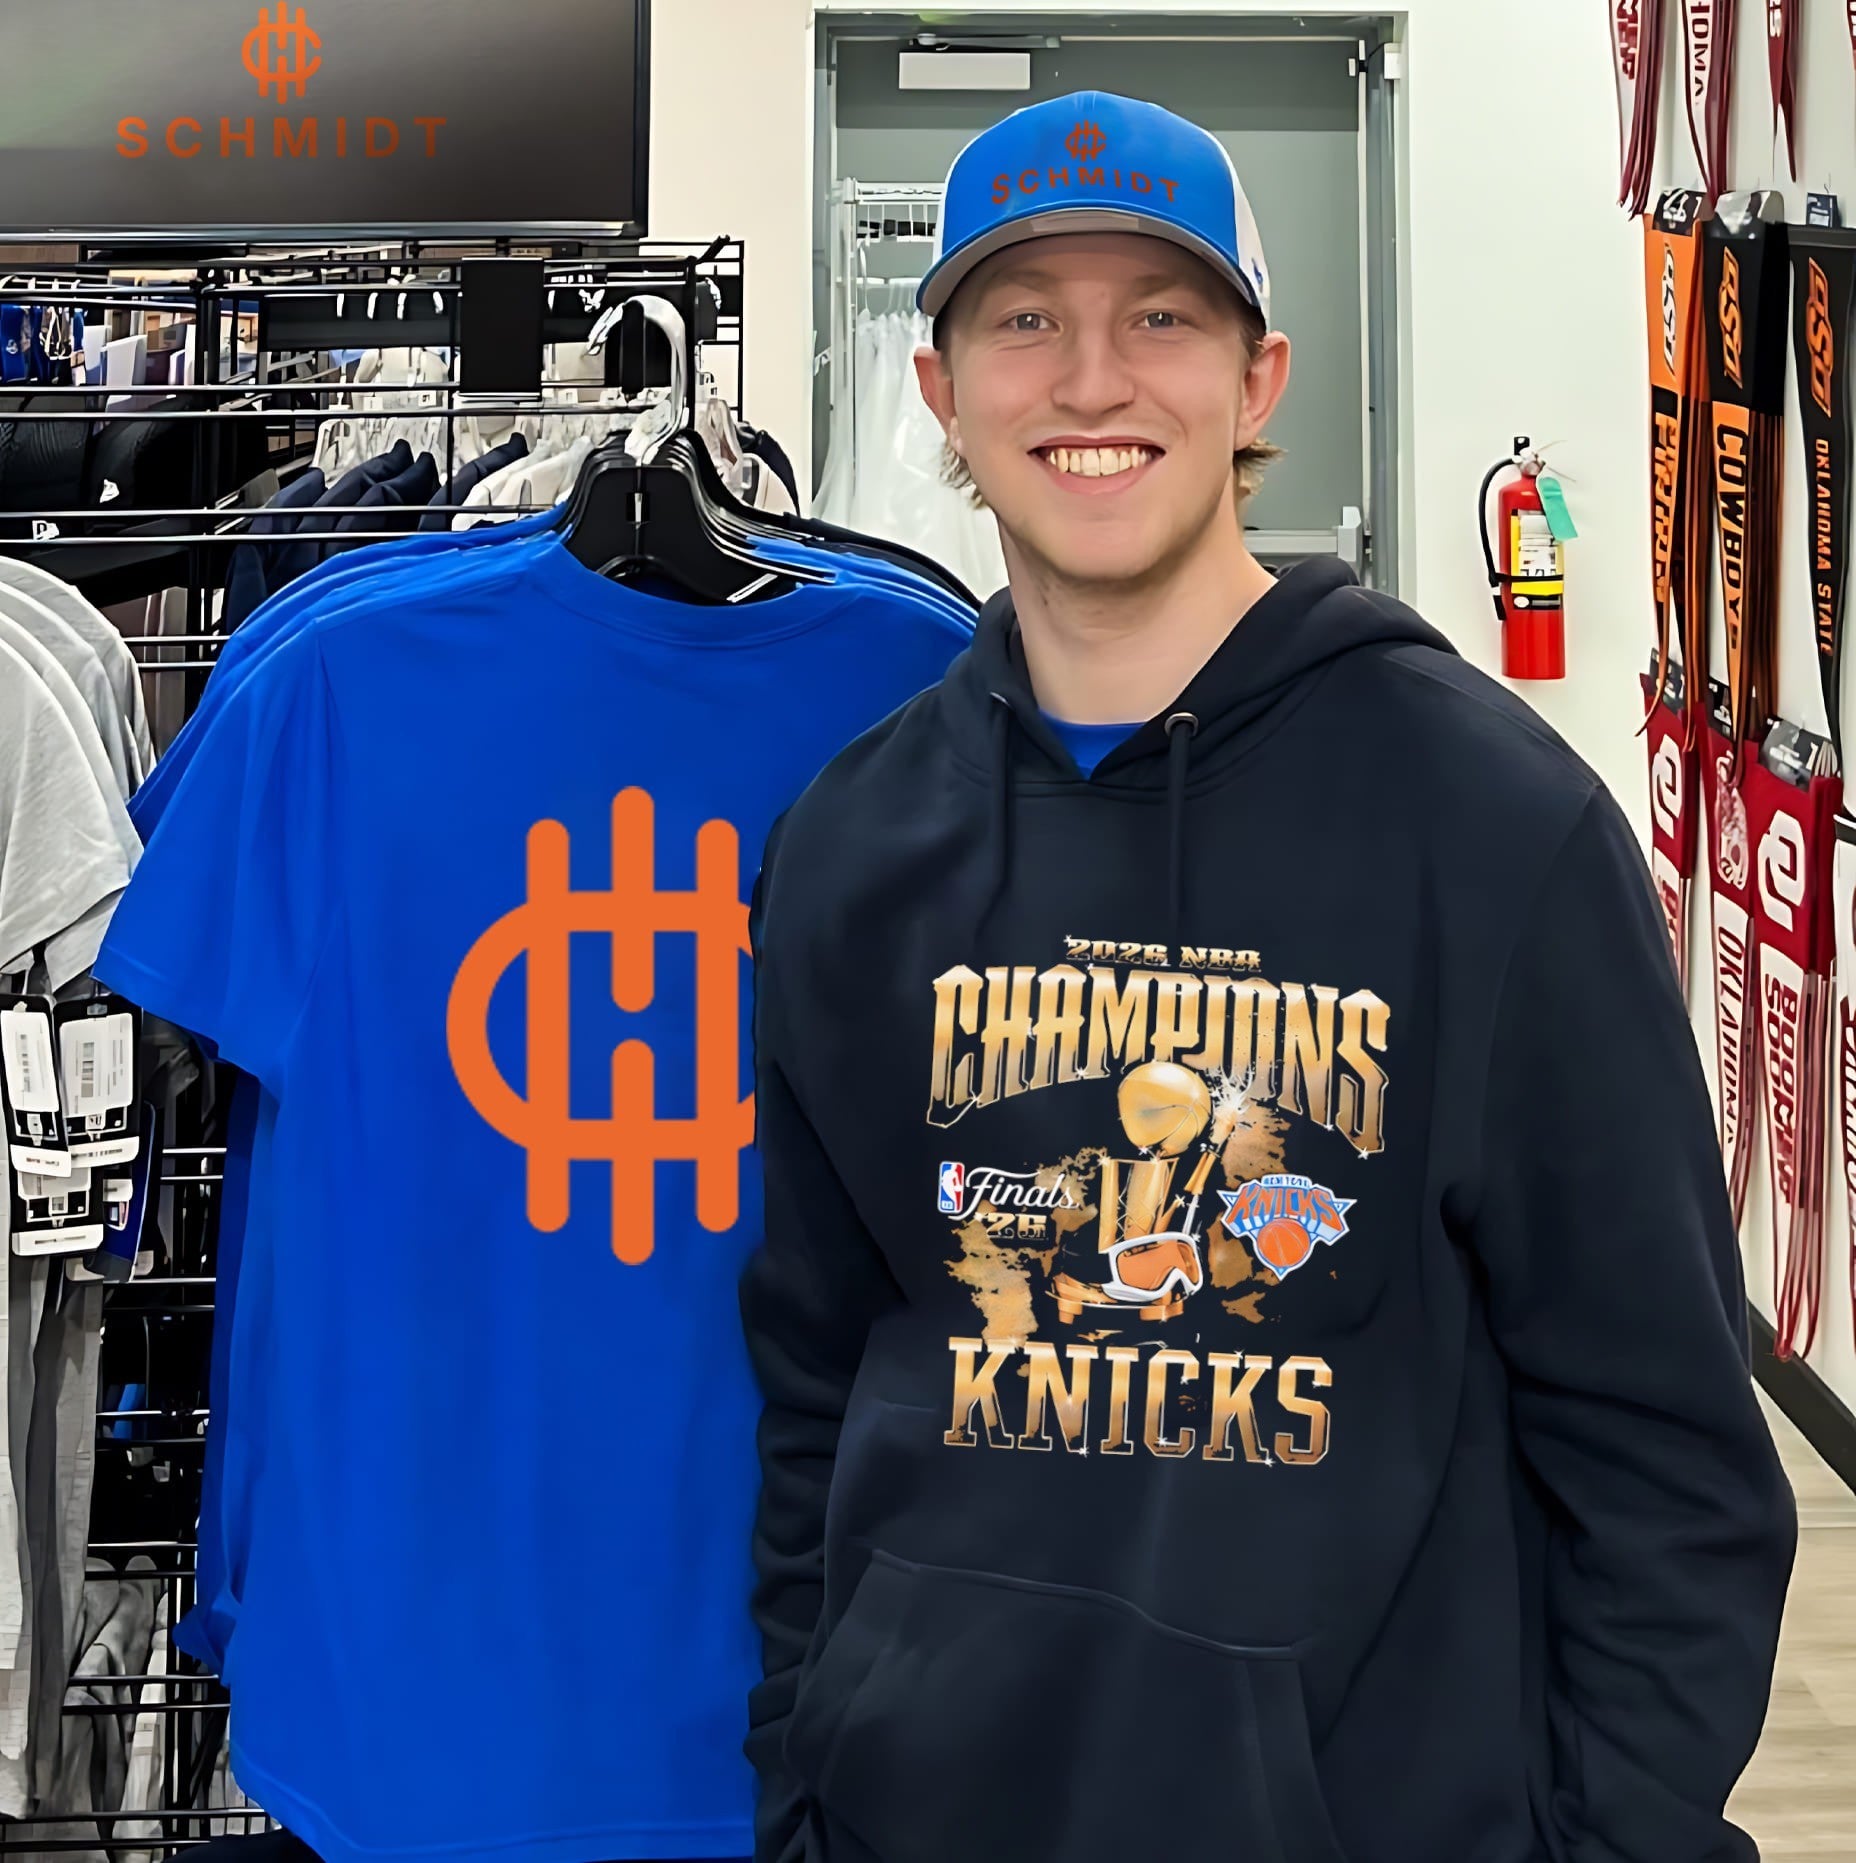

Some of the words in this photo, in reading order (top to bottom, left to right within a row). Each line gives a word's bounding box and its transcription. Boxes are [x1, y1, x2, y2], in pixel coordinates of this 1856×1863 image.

[117, 117, 448, 159] SCHMIDT
[990, 166, 1181, 205] SCHMIDT
[1815, 439, 1832, 571] OKLAHOMA
[1066, 938, 1170, 967] 2026
[1179, 946, 1262, 972] NBA
[926, 964, 1391, 1156] CHAMPIONS
[948, 1166, 1080, 1221] Finals
[1225, 1185, 1344, 1232] KNICKS
[943, 1335, 1334, 1466] KNICKS
